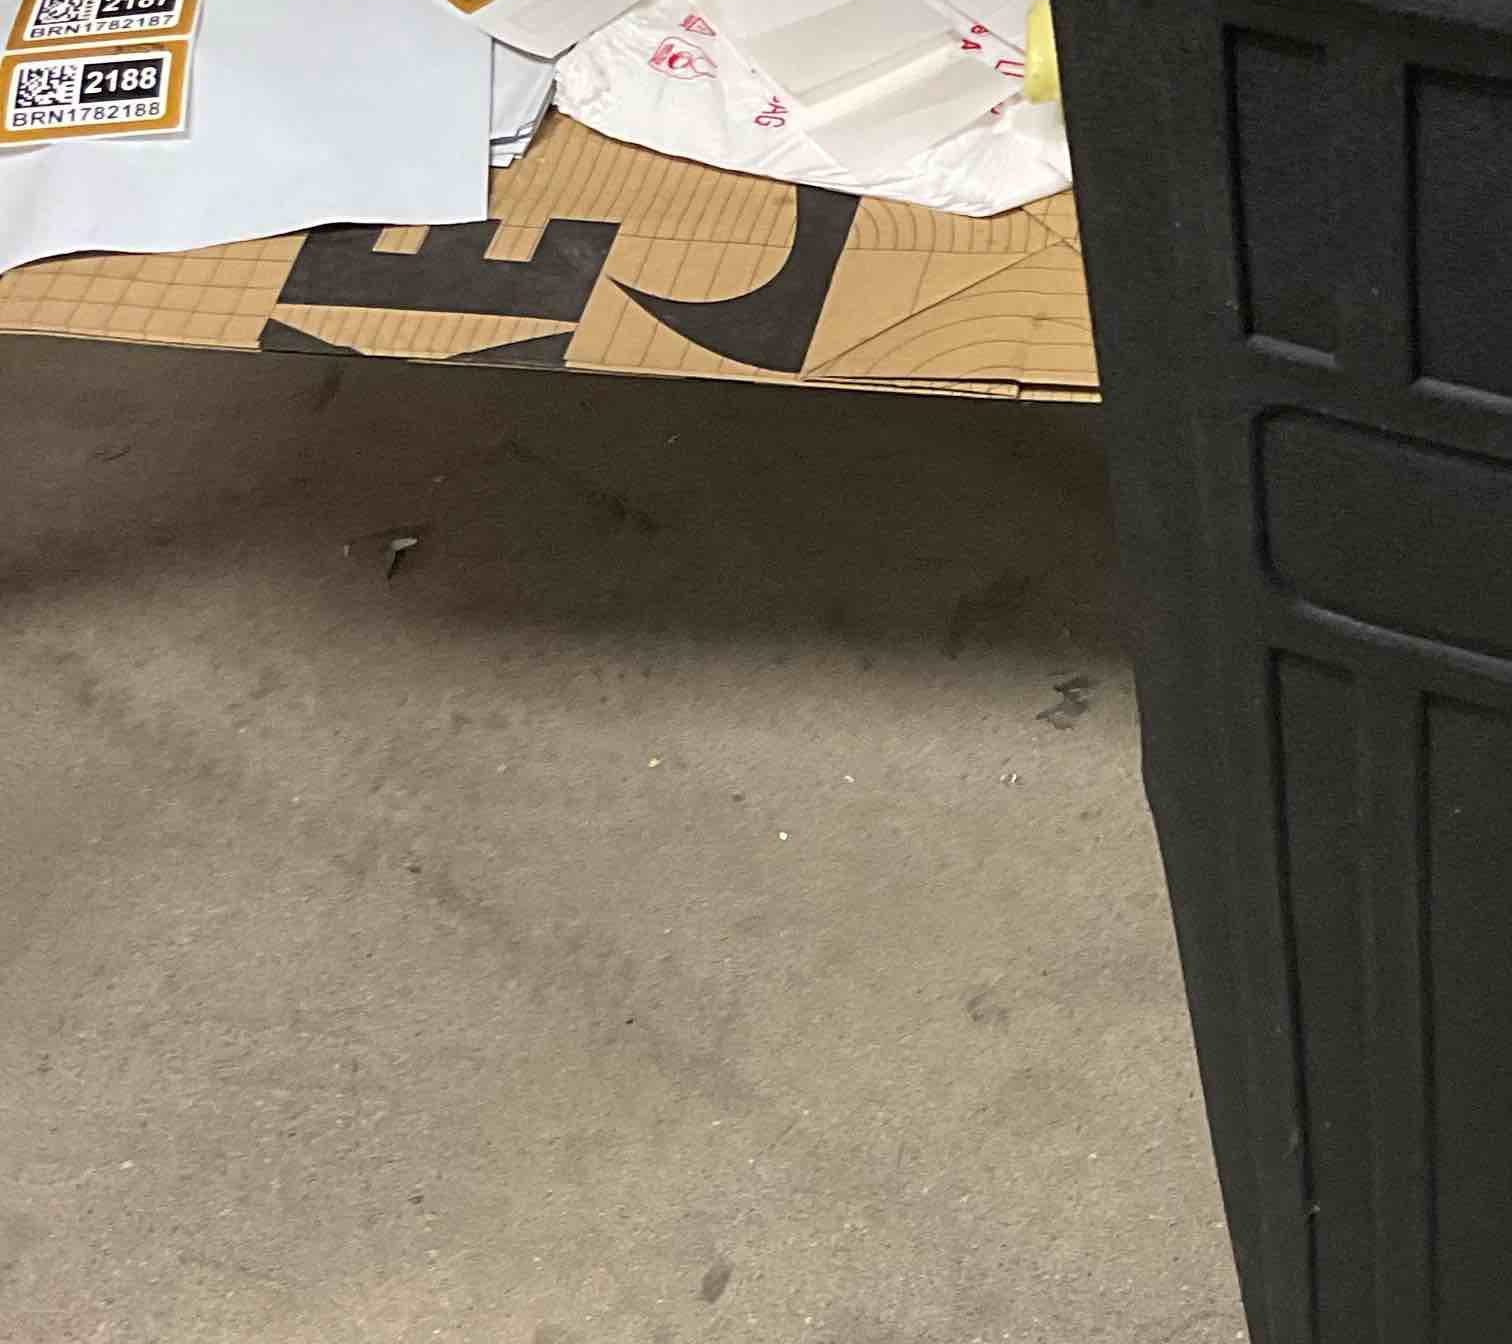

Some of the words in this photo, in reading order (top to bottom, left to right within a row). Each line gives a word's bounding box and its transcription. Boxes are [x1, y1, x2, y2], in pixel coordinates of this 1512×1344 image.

[28, 13, 175, 40] BRN1782187
[83, 66, 158, 95] 2188
[11, 101, 161, 128] BRN1782188
